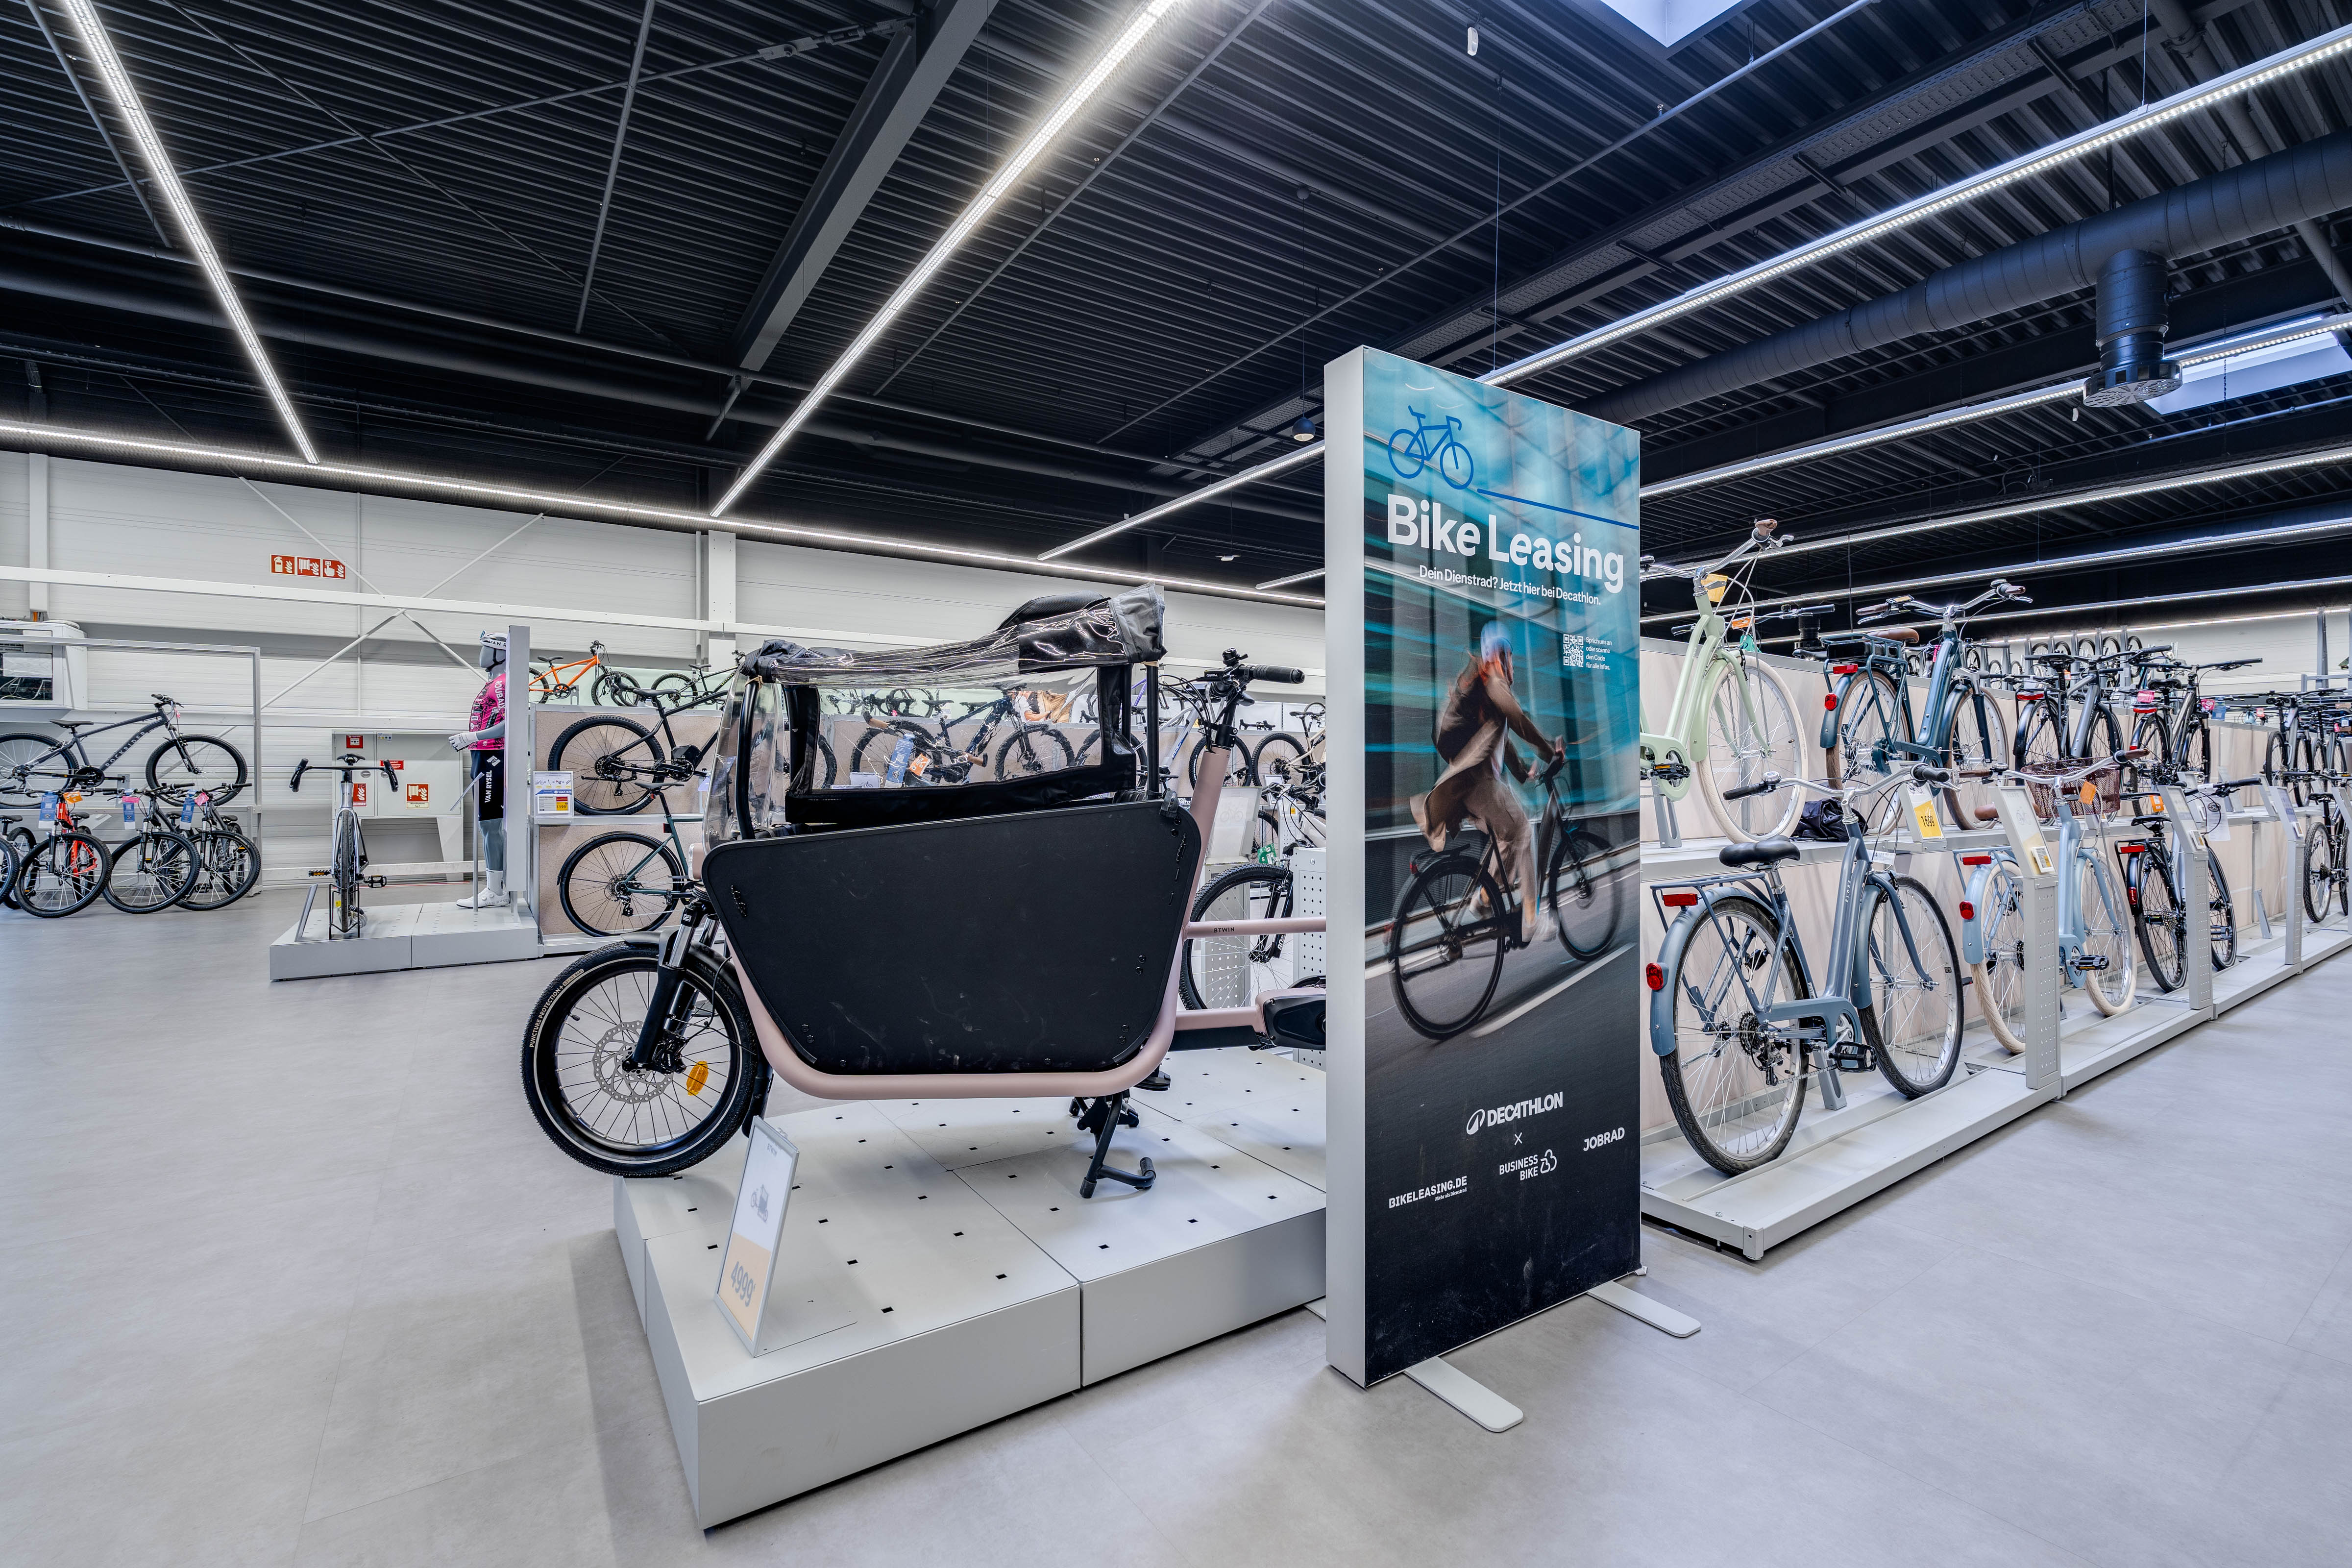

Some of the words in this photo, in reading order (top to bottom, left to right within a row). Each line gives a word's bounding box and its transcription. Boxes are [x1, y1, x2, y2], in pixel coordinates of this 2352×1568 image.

[1387, 494, 1480, 556] Bike
[1488, 514, 1624, 593] Leasing
[1420, 565, 1443, 581] Dein
[1445, 569, 1498, 588] Dienstrad?
[1499, 579, 1522, 593] Jetzt
[1523, 582, 1540, 595] hier
[1541, 585, 1555, 598] bei
[1556, 588, 1601, 605] Decathlon.
[105, 732, 146, 767] ROCKRIDER
[530, 1019, 541, 1048] PUNCTURE
[1487, 1091, 1563, 1127] DECATHLON
[766, 1143, 778, 1157] BTWIN
[1583, 1127, 1625, 1152] JOBRAD
[1499, 1154, 1538, 1175] BUSINESS
[1520, 1166, 1538, 1181] BIKE
[1389, 1176, 1468, 1209] BIKELEASING.DE
[1450, 1187, 1467, 1197] Dienstrad
